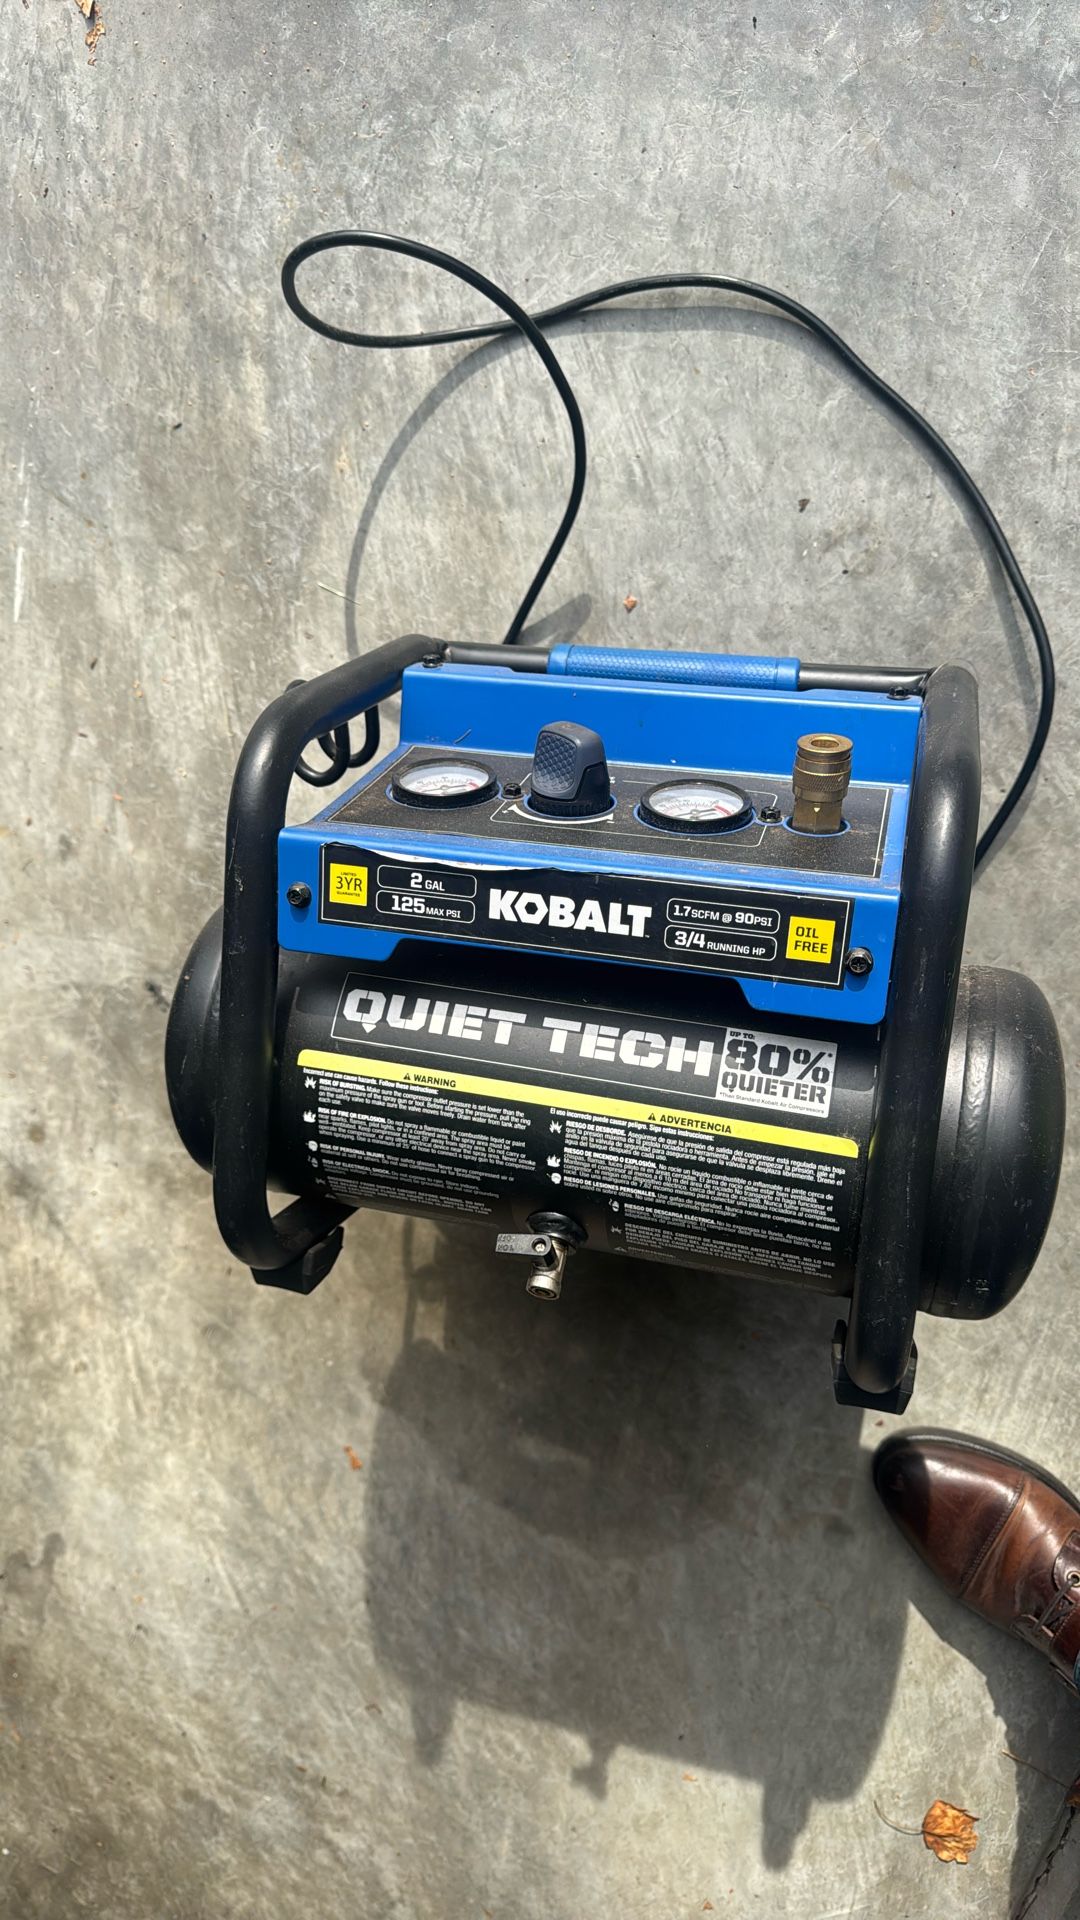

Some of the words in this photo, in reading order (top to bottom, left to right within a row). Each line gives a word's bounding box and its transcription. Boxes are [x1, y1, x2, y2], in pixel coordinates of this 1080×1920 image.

[336, 876, 362, 891] 3YR
[410, 872, 422, 888] 2
[425, 880, 445, 891] GAL
[446, 910, 461, 918] PSI
[488, 888, 652, 938] KOBALT
[722, 913, 731, 923] @
[795, 926, 819, 938] OIL
[674, 931, 705, 948] 3/4
[706, 942, 750, 954] RUNNING
[752, 947, 766, 956] HP
[794, 940, 828, 954] FREE
[343, 988, 527, 1045] QUIET
[542, 1016, 715, 1077] TECH
[414, 1074, 456, 1088] WARNING
[721, 1071, 827, 1104] QUIETER
[735, 1095, 761, 1104] Standard
[761, 1099, 779, 1107] Kobalt
[788, 1103, 825, 1114] Compressors
[660, 1115, 731, 1133] ADVERTENCIA
